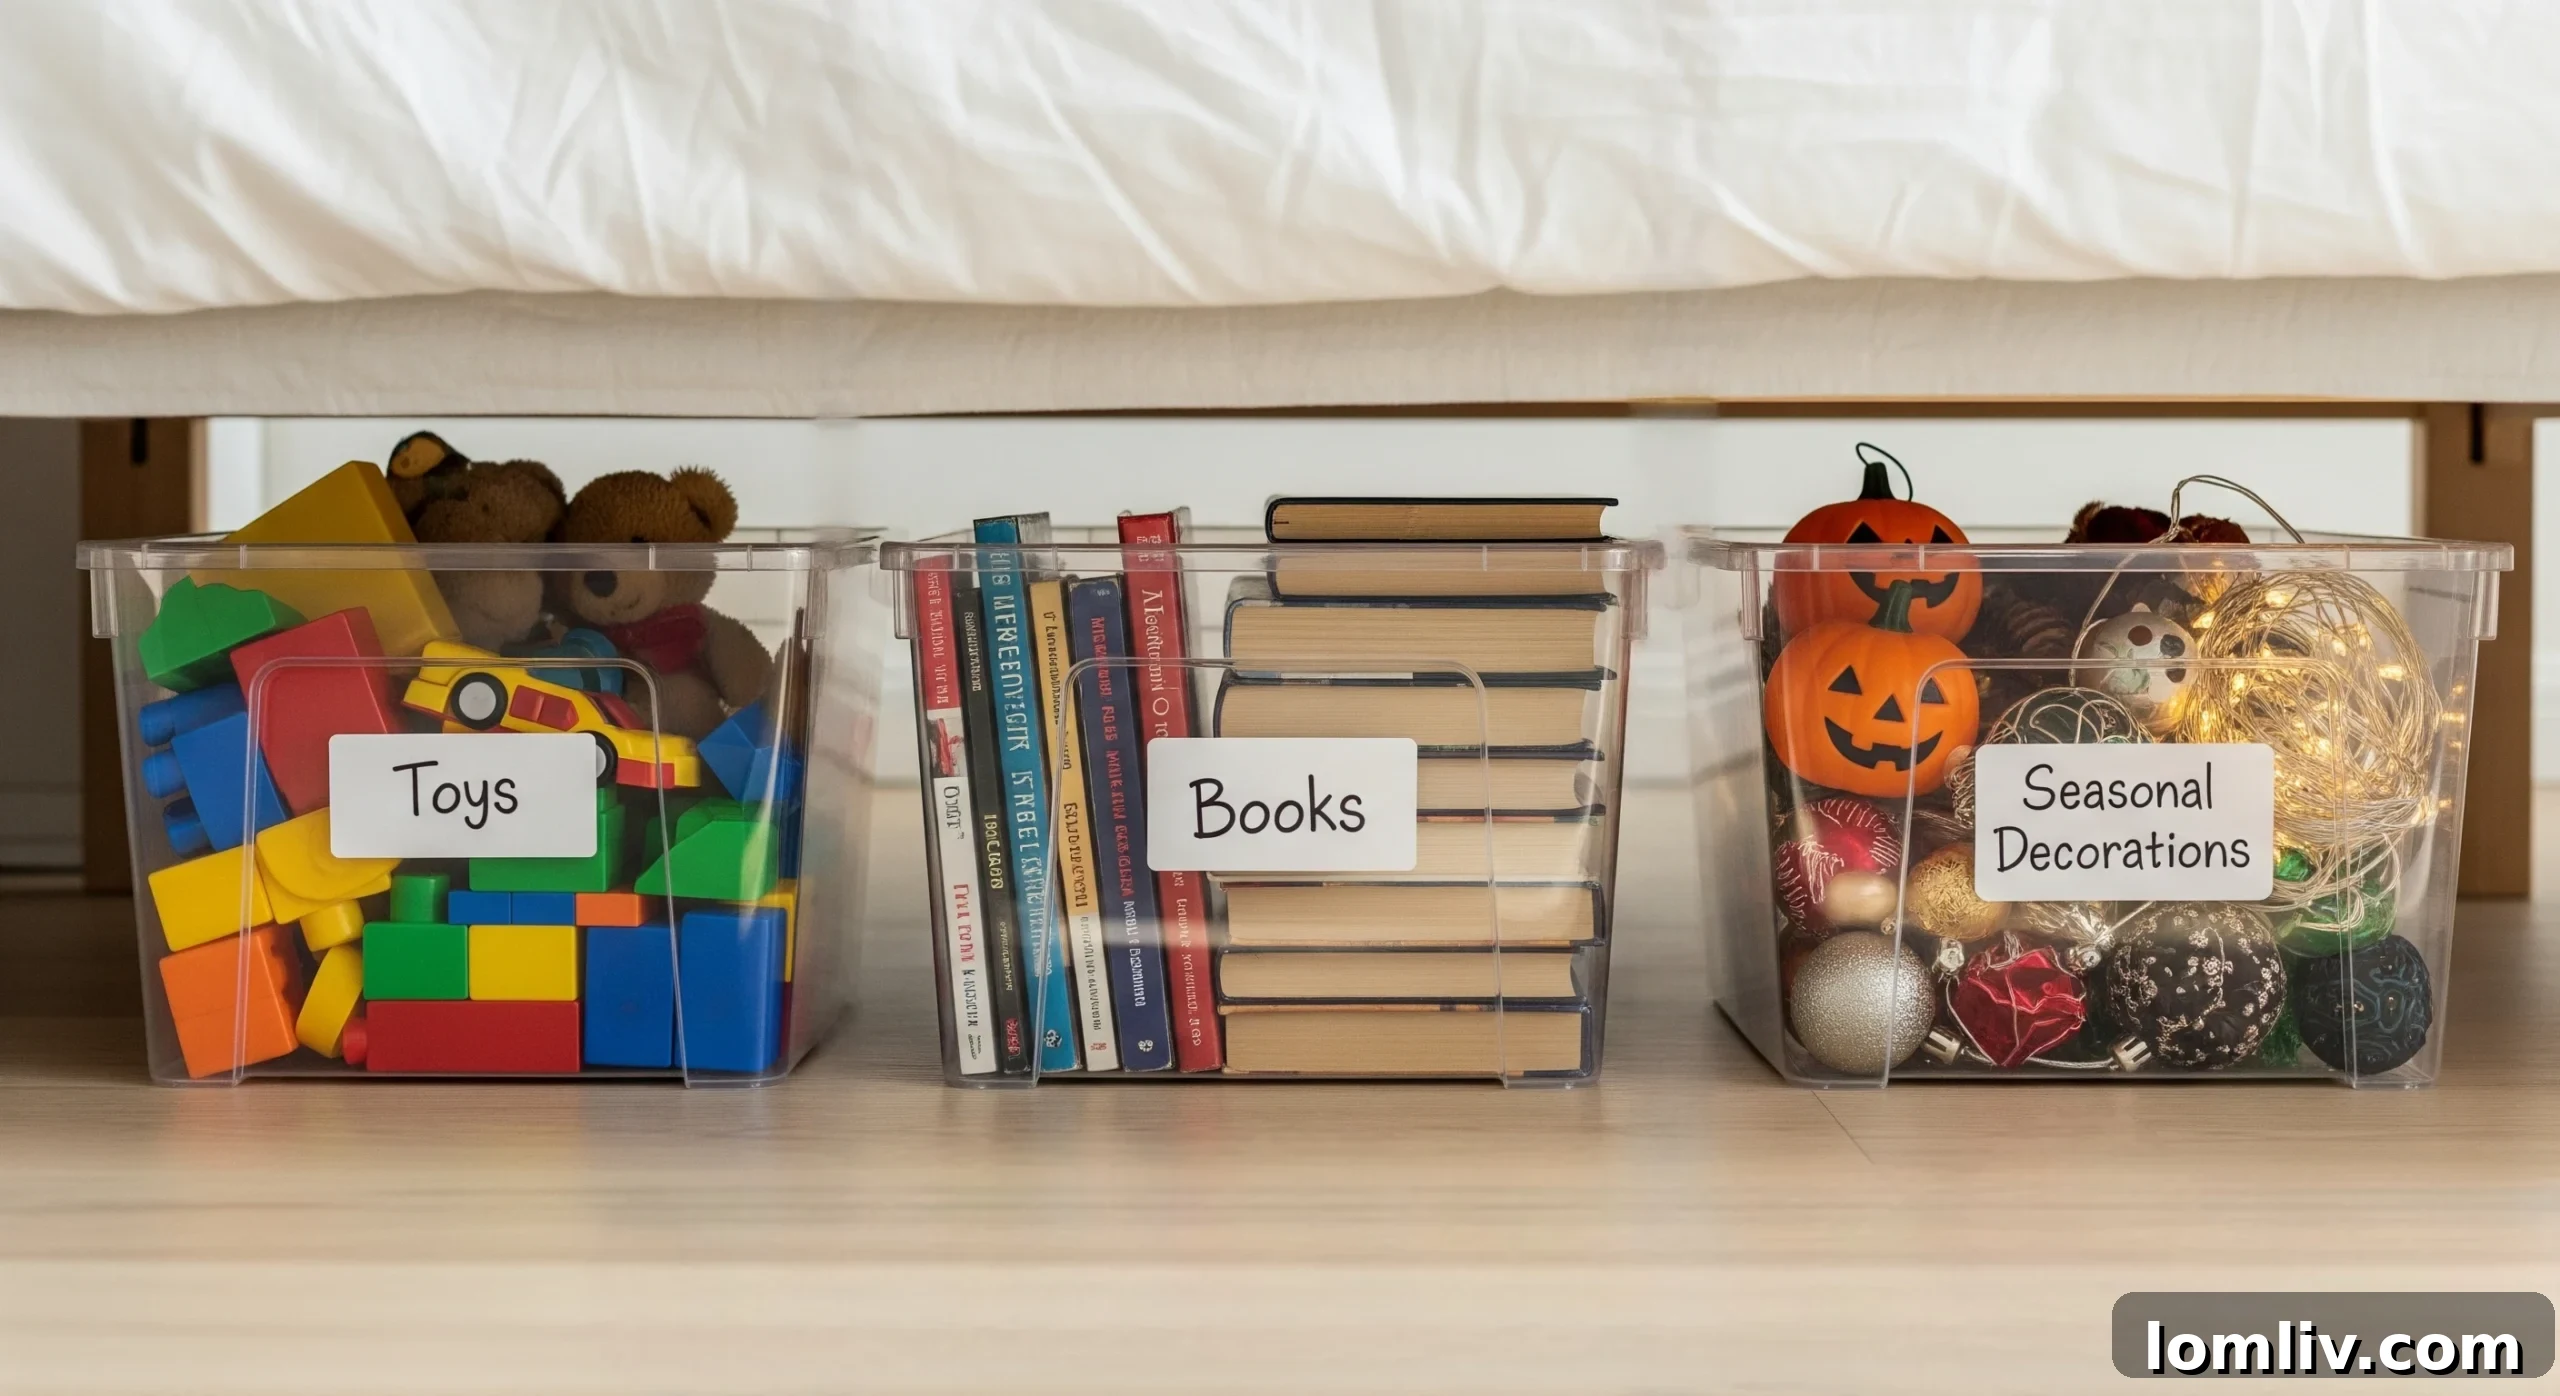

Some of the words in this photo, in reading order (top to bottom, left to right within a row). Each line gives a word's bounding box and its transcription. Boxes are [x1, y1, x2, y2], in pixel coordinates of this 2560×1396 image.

[392, 760, 518, 830] Toys
[1188, 774, 1366, 840] Books
[2022, 761, 2213, 811] Seasonal
[1993, 825, 2250, 873] Decorations
